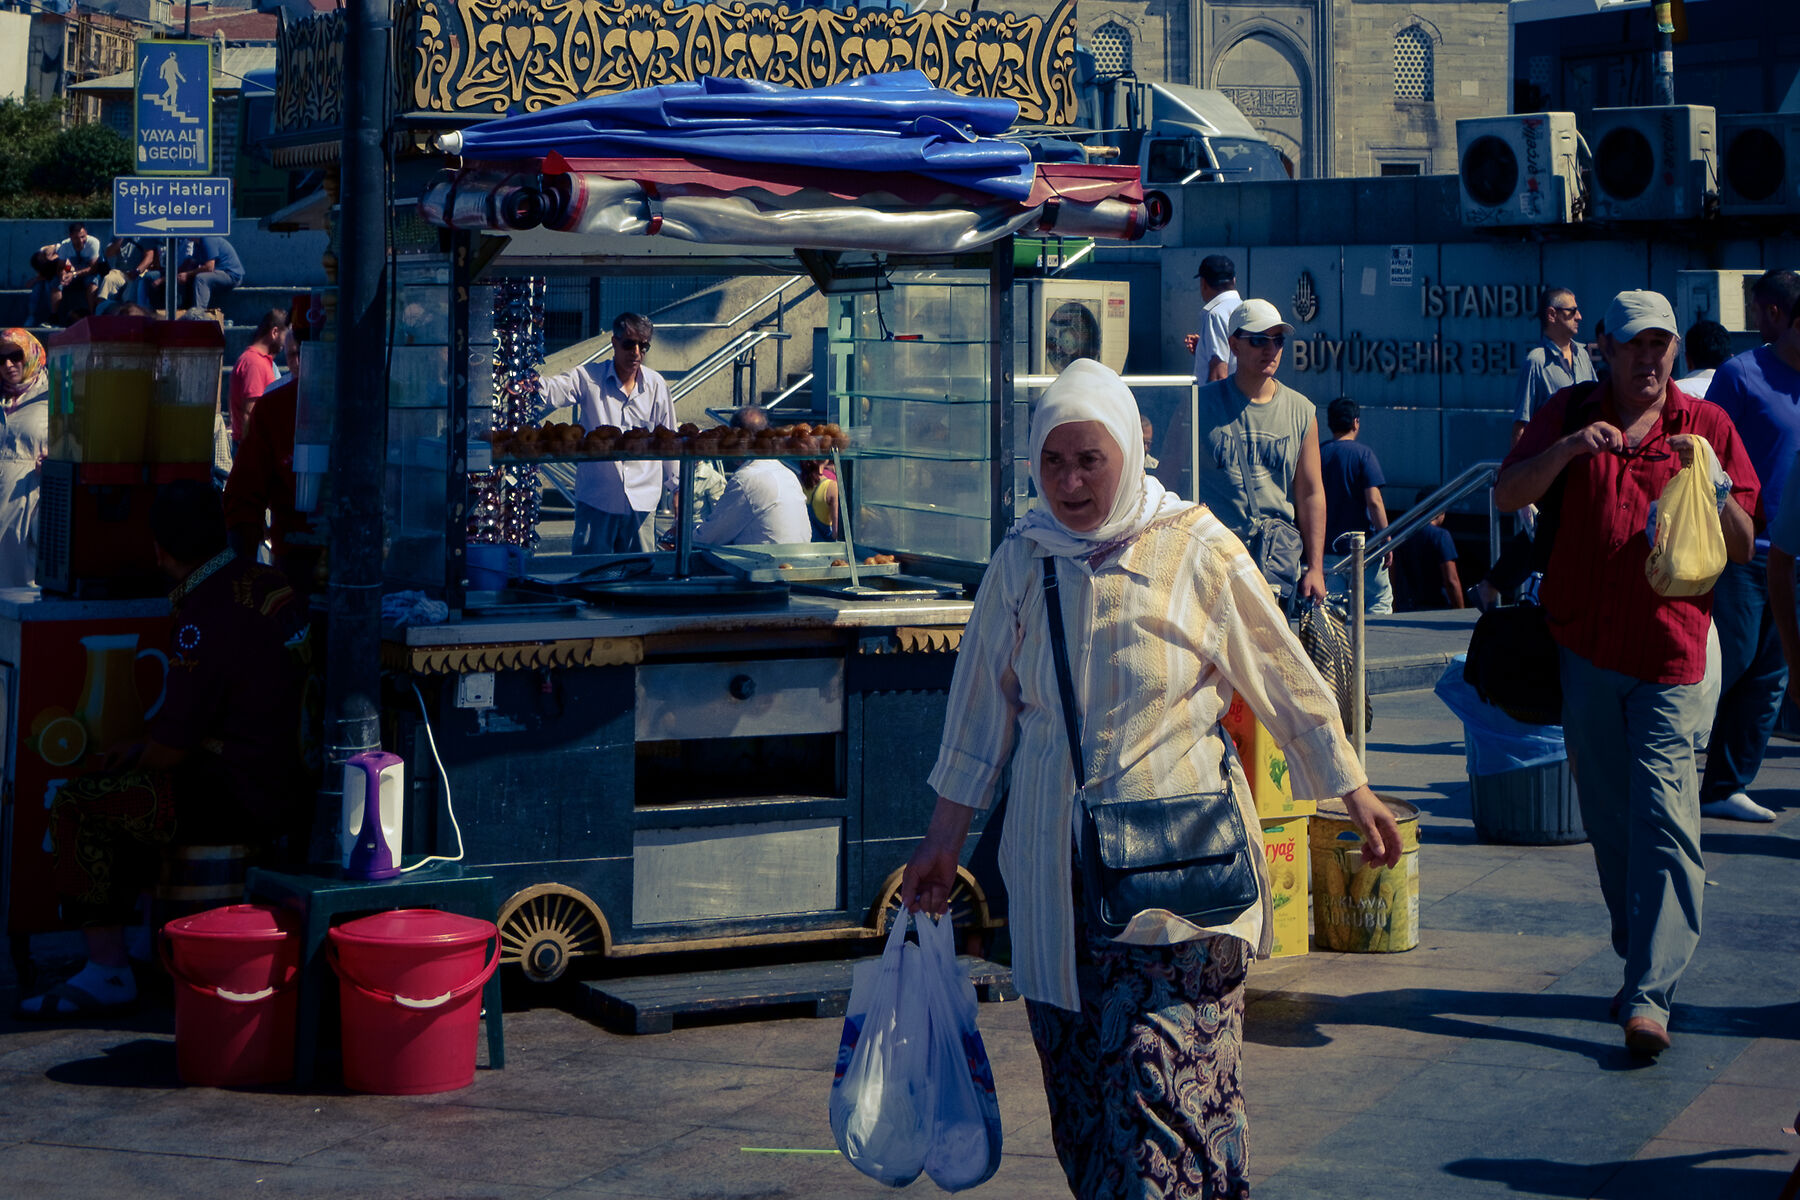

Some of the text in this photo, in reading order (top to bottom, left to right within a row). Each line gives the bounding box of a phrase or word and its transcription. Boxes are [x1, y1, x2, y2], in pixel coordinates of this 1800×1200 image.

[141, 128, 203, 142] YAYA AL
[148, 144, 196, 162] GEÇİDİ
[119, 182, 225, 198] Şehir Hatları
[134, 197, 211, 215] İskeleleri
[1421, 276, 1546, 317] İSTANBU
[1293, 332, 1462, 381] BÜYÜKŞEHİR
[1216, 430, 1290, 474] EVRLAST
[1263, 837, 1296, 864] ryağ
[1320, 910, 1388, 929] URUBU
